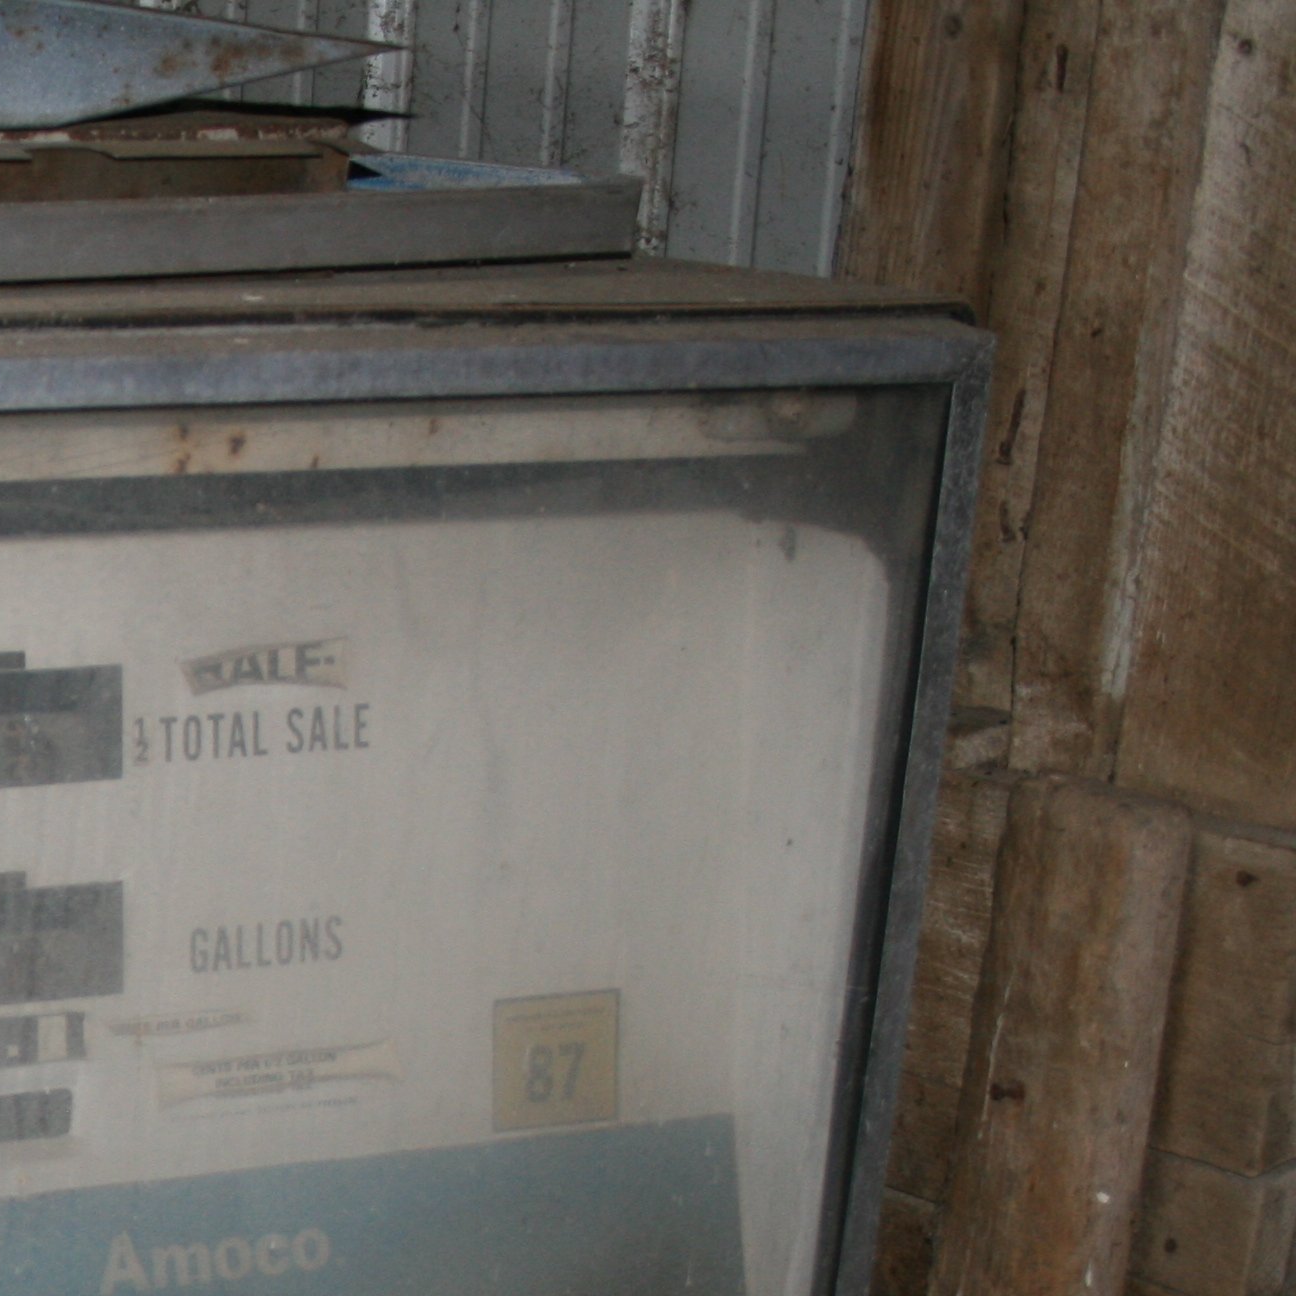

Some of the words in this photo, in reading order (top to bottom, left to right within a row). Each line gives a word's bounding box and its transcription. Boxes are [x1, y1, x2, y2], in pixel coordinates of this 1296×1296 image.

[159, 709, 269, 763] TOTAL
[285, 702, 372, 754] SALE
[189, 917, 344, 974] GALLONS
[526, 1041, 586, 1104] 87
